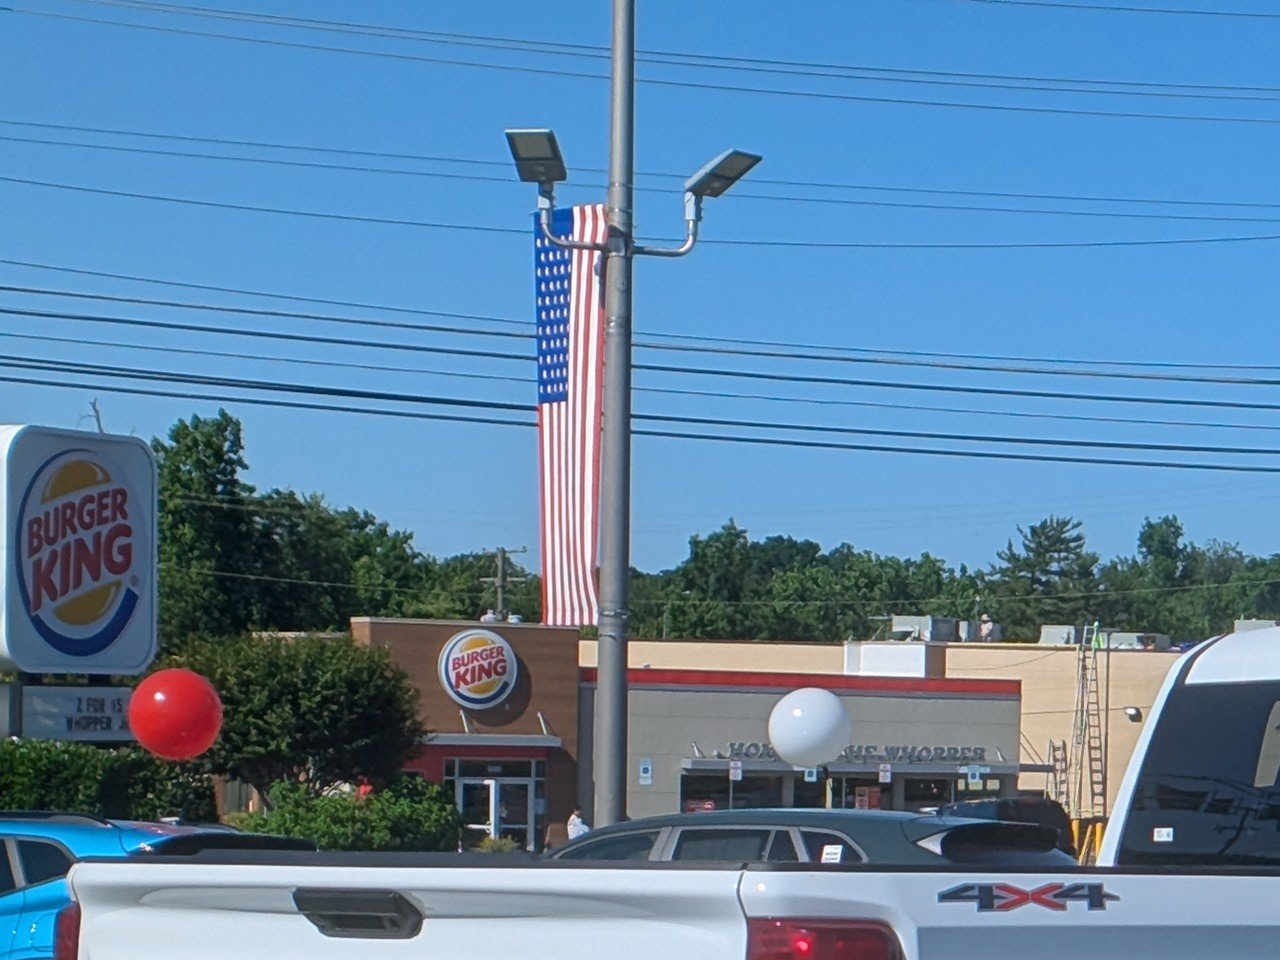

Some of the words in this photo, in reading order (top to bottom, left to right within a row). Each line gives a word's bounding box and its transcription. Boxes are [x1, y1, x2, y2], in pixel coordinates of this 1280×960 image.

[27, 487, 129, 558] BURGER
[31, 523, 133, 613] KING
[452, 646, 505, 671] BURGER
[455, 658, 507, 689] KING
[883, 745, 986, 763] WHOPPER
